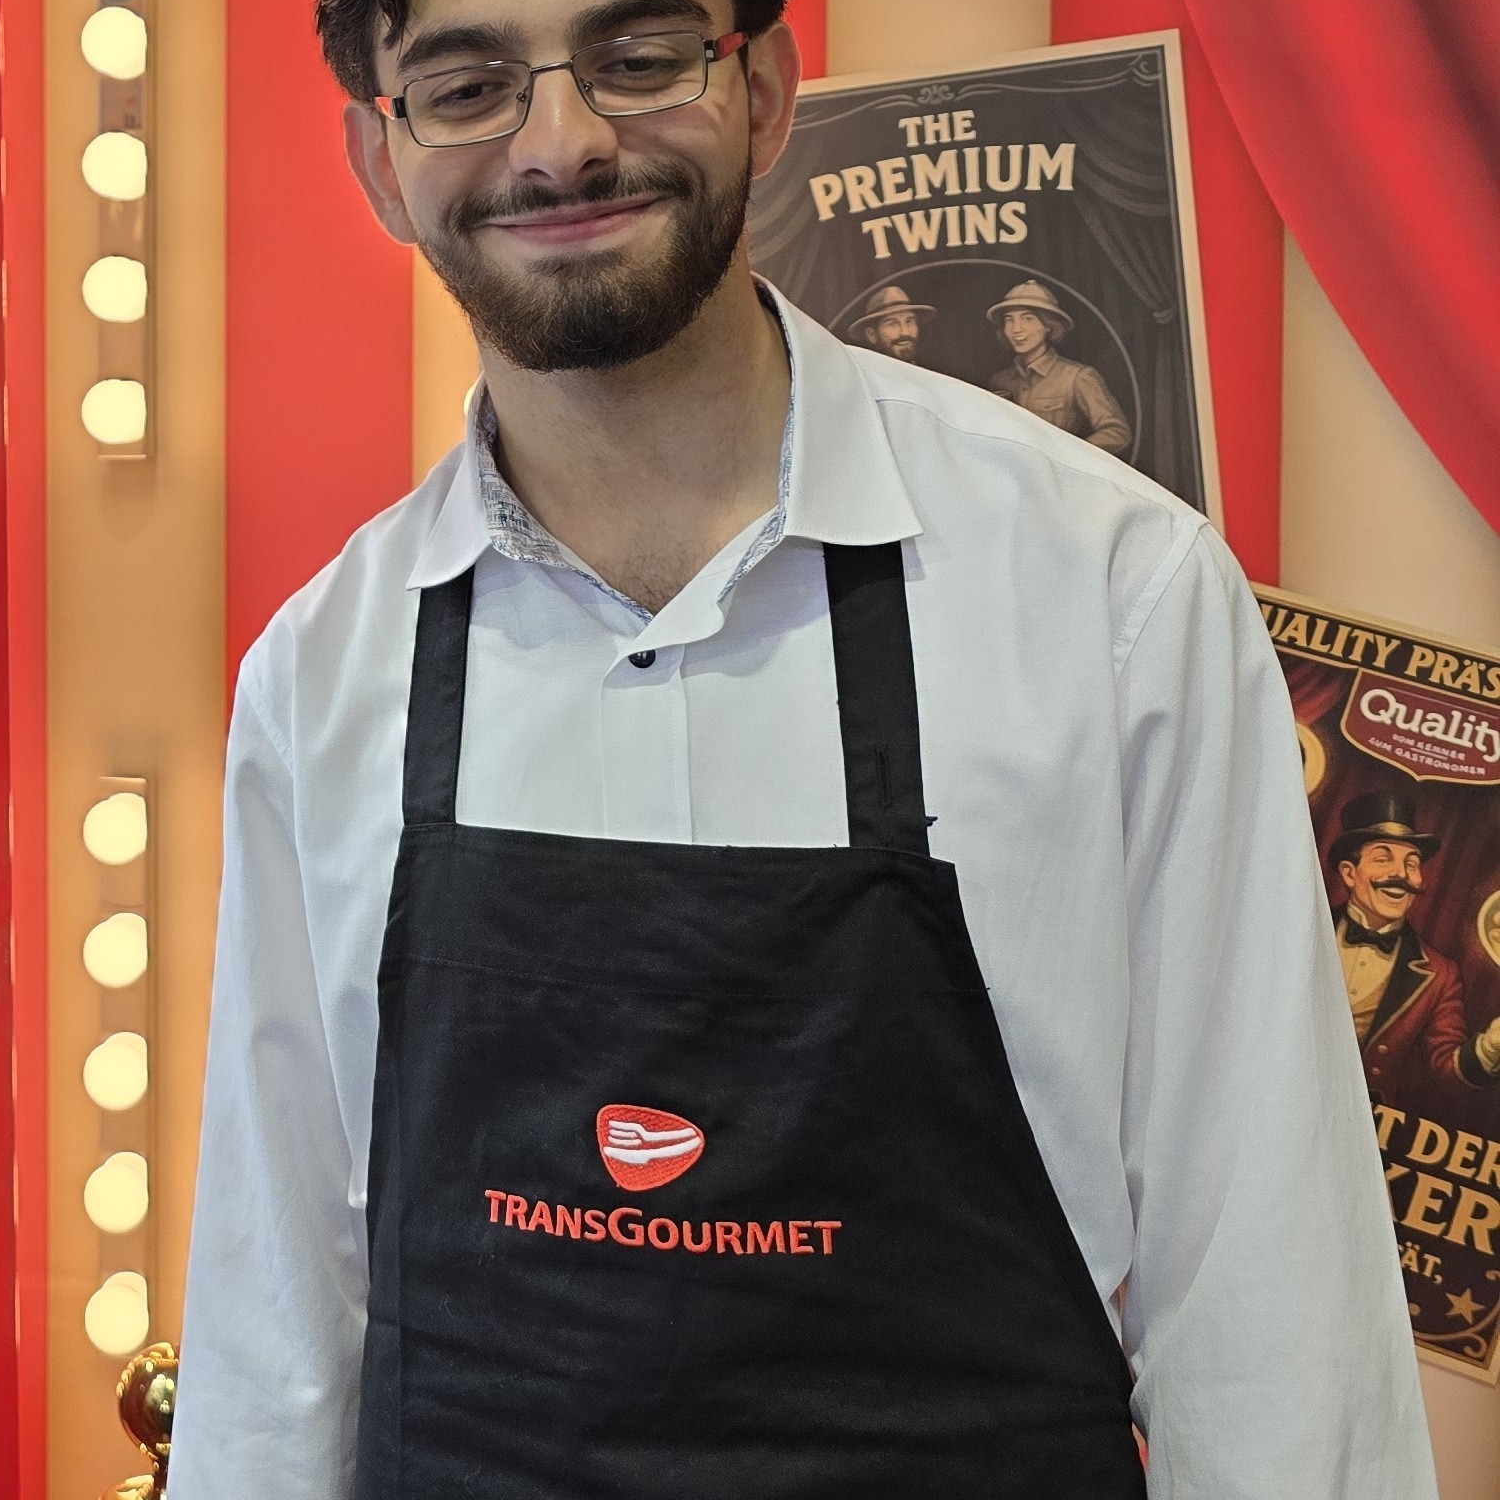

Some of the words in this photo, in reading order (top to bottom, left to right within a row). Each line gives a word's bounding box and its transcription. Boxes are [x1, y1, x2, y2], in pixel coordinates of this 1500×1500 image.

[897, 110, 977, 148] THE
[808, 142, 1077, 222] PREMIUM
[862, 201, 1028, 260] TWINS
[1260, 603, 1401, 669] UALITY
[1360, 688, 1500, 763] Quality
[1406, 1117, 1500, 1189] DER
[484, 1189, 842, 1255] TRANSGOURMET
[1398, 1241, 1444, 1286] ÄT,
